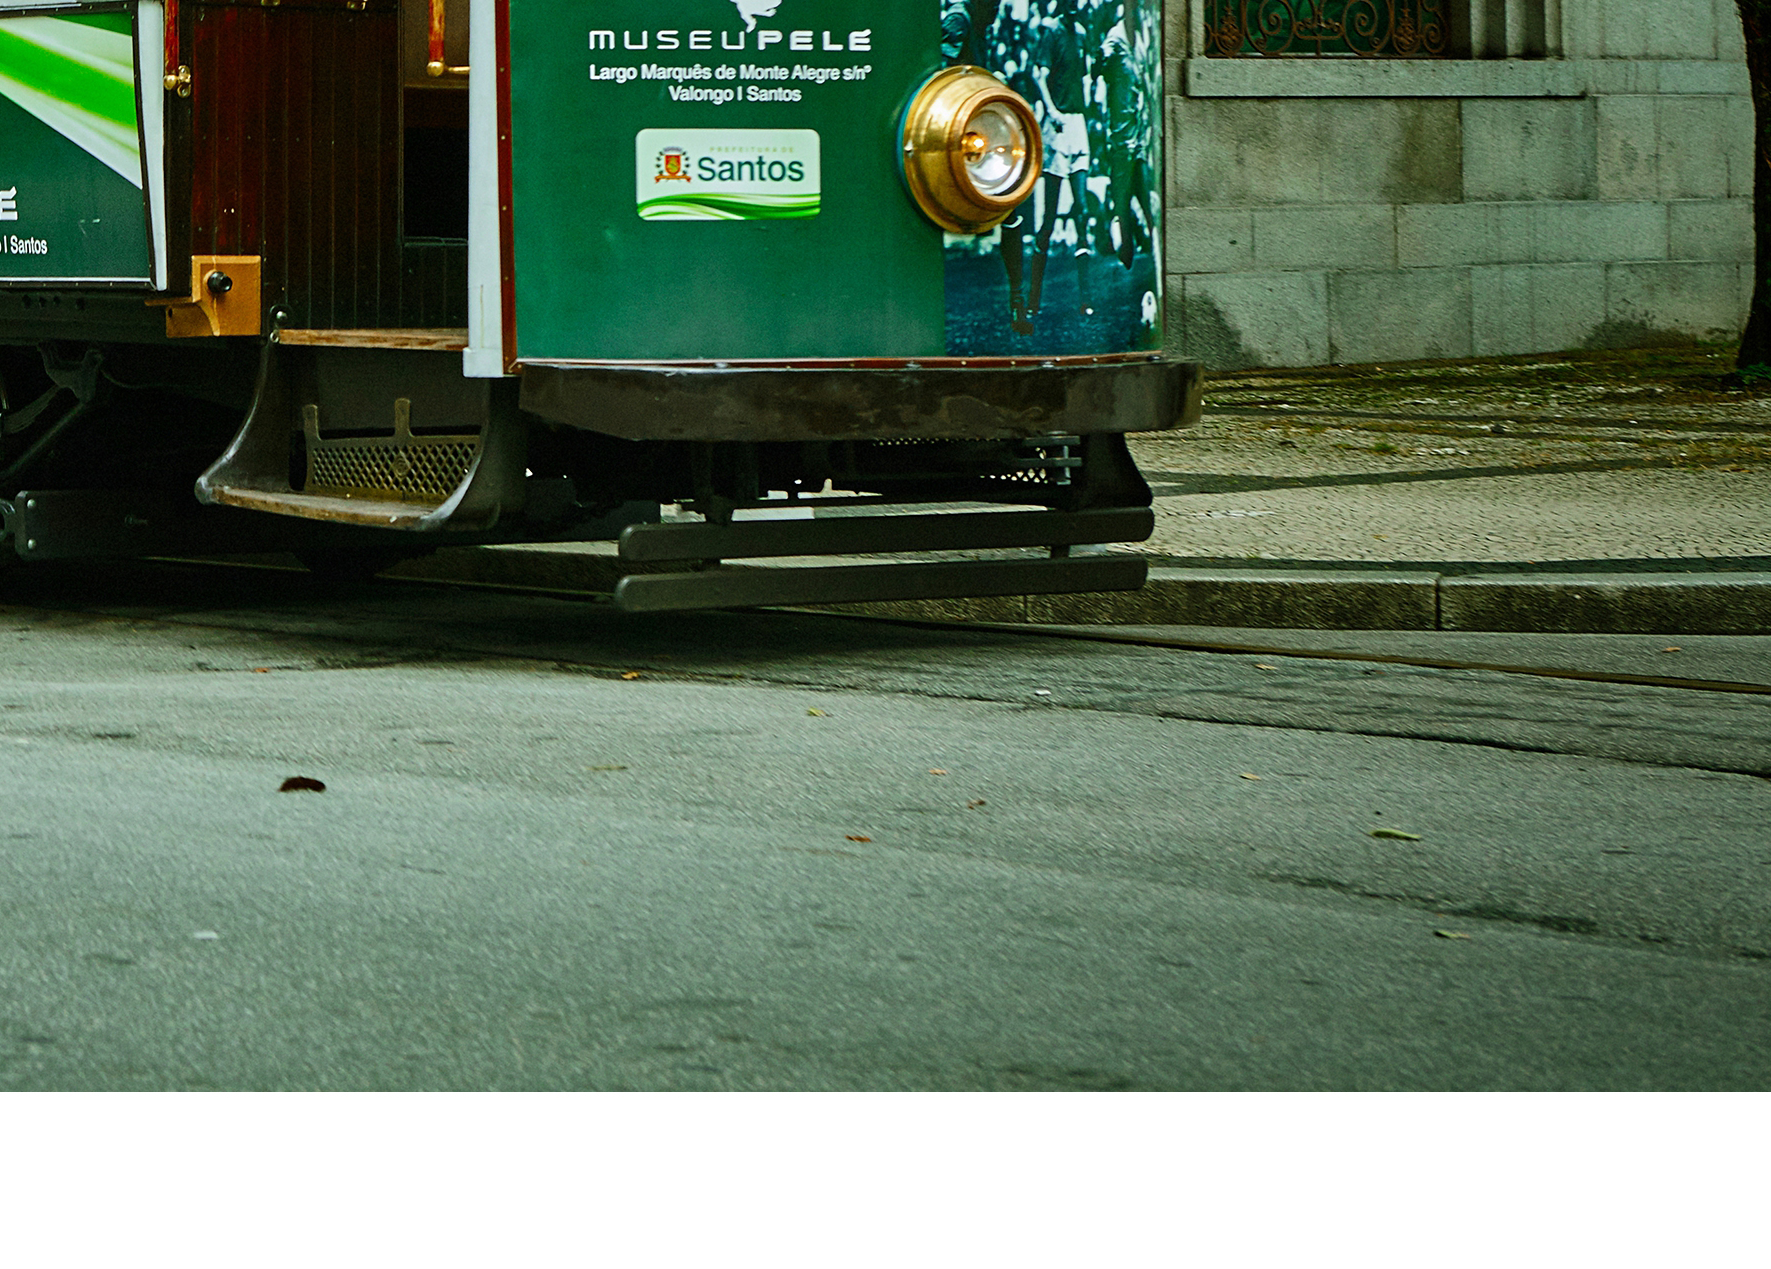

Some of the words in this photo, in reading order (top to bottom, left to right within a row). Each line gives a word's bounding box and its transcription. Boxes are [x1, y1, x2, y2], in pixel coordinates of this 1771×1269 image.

[589, 63, 638, 84] Largo
[640, 63, 713, 83] Marquês
[714, 64, 737, 80] de
[739, 64, 790, 80] Monte
[791, 64, 841, 84] Alegre
[668, 85, 735, 105] Valongo
[746, 85, 802, 102] Santos
[697, 155, 805, 182] Santos
[10, 235, 48, 255] Santos
